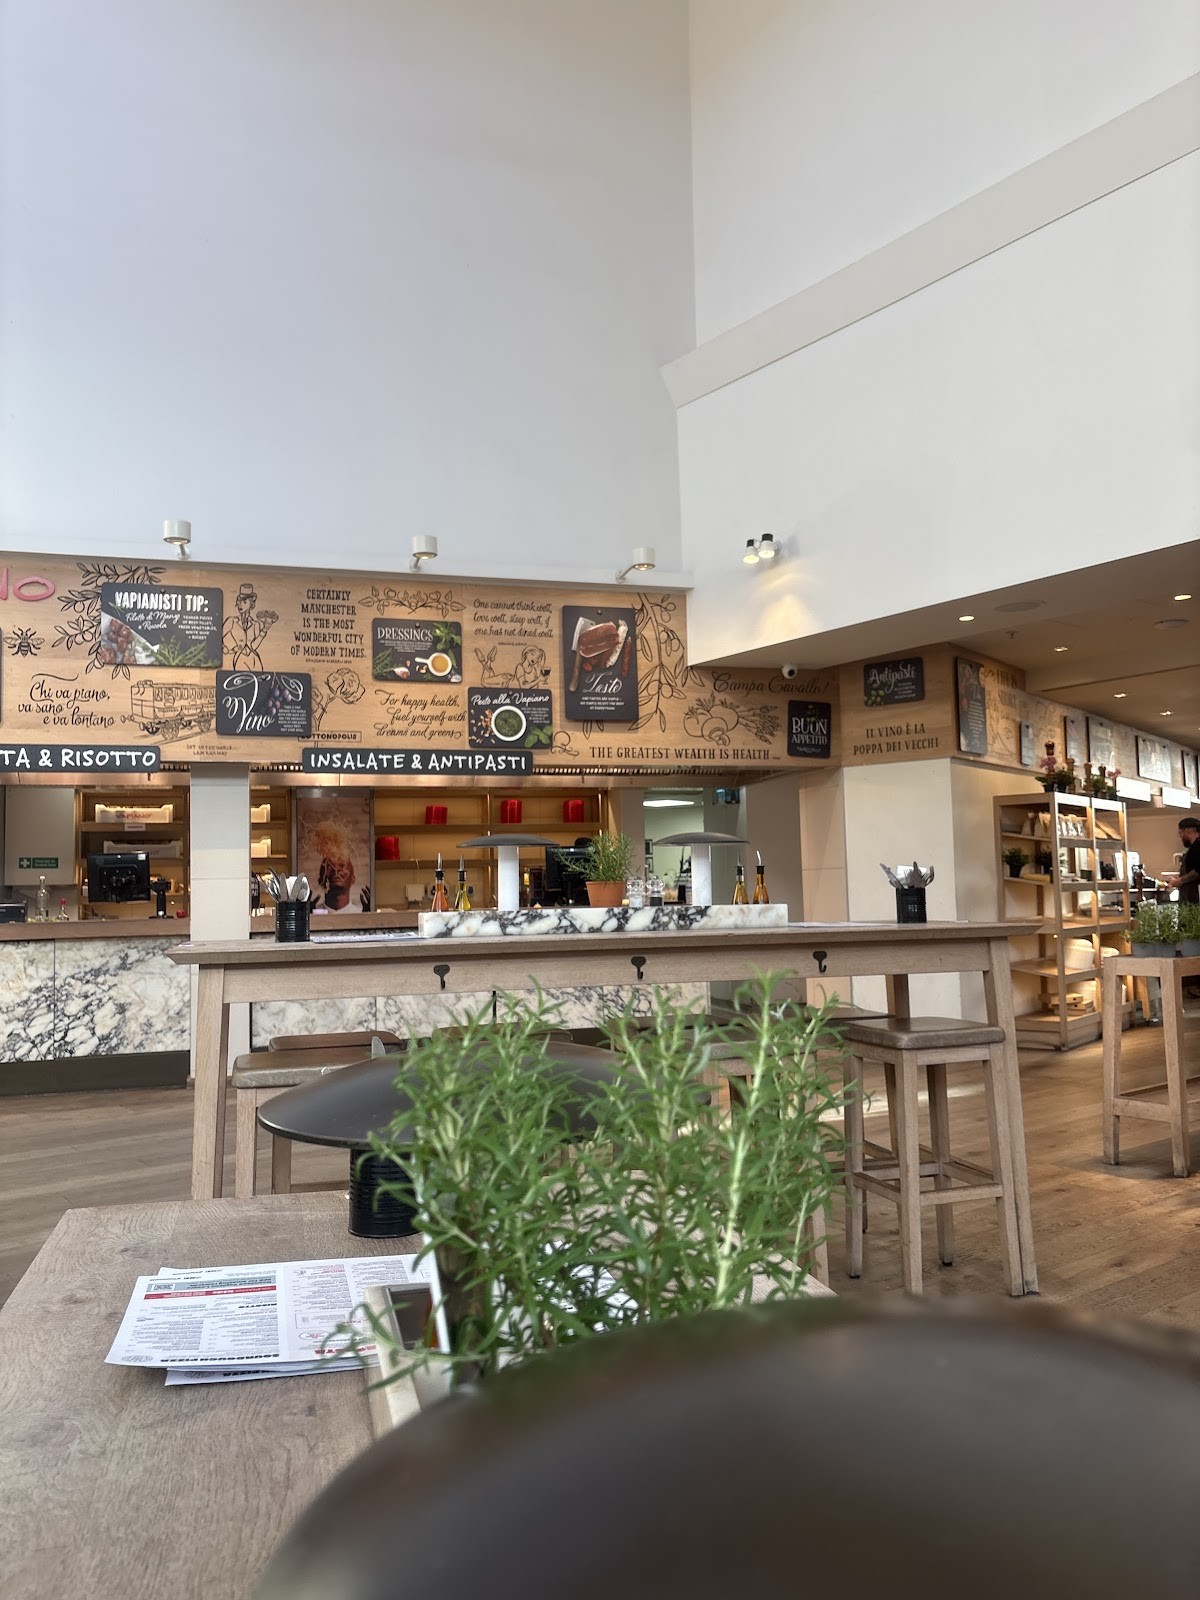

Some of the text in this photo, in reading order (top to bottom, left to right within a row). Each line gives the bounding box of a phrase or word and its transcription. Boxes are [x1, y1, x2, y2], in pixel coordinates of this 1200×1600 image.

[114, 591, 209, 612] VAPIANISTI TIP:
[306, 588, 351, 601] CERTAINLY
[301, 603, 356, 616] MANCHESTER
[473, 598, 490, 608] One
[490, 600, 515, 610] cannot
[516, 600, 536, 612] think
[303, 618, 355, 630] IS THE MOST
[488, 626, 502, 636] has
[504, 628, 516, 636] not
[294, 632, 364, 644] WONDERFUL CITY
[377, 627, 434, 641] DRESSINGS
[290, 645, 366, 658] OF MODERN TIMES.
[712, 671, 765, 697] Campa
[866, 662, 916, 694] Antipasti
[30, 679, 110, 709] Chi va piano,
[374, 689, 460, 711] For happy health,
[471, 692, 550, 707] Pesto alla Vapiano
[18, 703, 64, 715] va sano
[222, 672, 275, 734] Vino
[43, 706, 115, 728] e va lontano
[387, 707, 467, 726] fuel yourself with
[374, 722, 462, 740] dreams and greens
[792, 717, 827, 735] BUON
[866, 729, 874, 739] IL
[878, 726, 902, 737] VINO
[914, 723, 926, 734] LA
[791, 734, 828, 745] APPETITO
[853, 737, 939, 756] POPPA DEI VECCHI
[0, 748, 156, 769] TA & RISOTTO
[310, 752, 526, 771] INSALATE & ANTIPASTI
[589, 746, 612, 758] THE
[616, 747, 670, 759] GREATEST
[674, 748, 716, 760] WEALTH
[719, 749, 729, 759] IS
[732, 749, 769, 760] HEALTH
